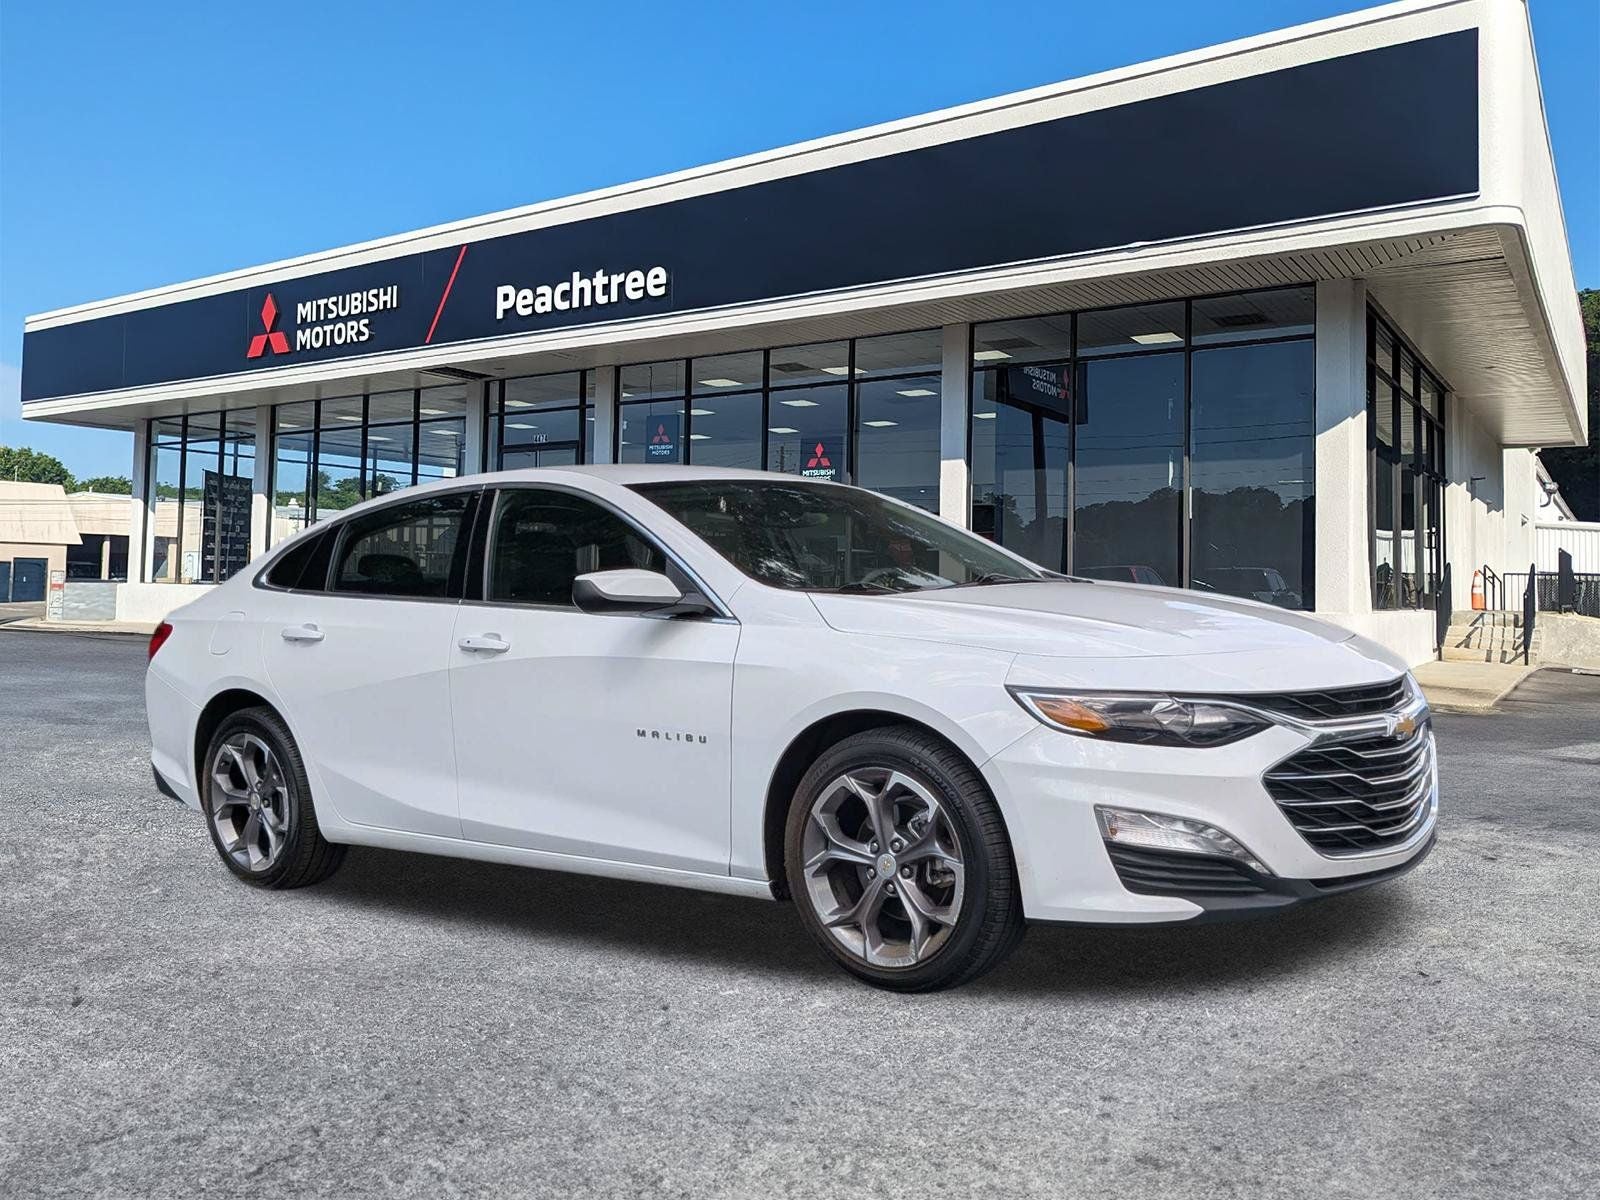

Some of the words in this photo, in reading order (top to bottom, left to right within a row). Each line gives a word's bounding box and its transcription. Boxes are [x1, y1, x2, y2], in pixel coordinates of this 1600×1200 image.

[296, 285, 398, 325] MITSUBISHI
[495, 266, 667, 320] Peachtree
[296, 319, 370, 351] MOTORS
[802, 469, 836, 477] MITSUBISHI
[636, 728, 707, 744] MALIBU
